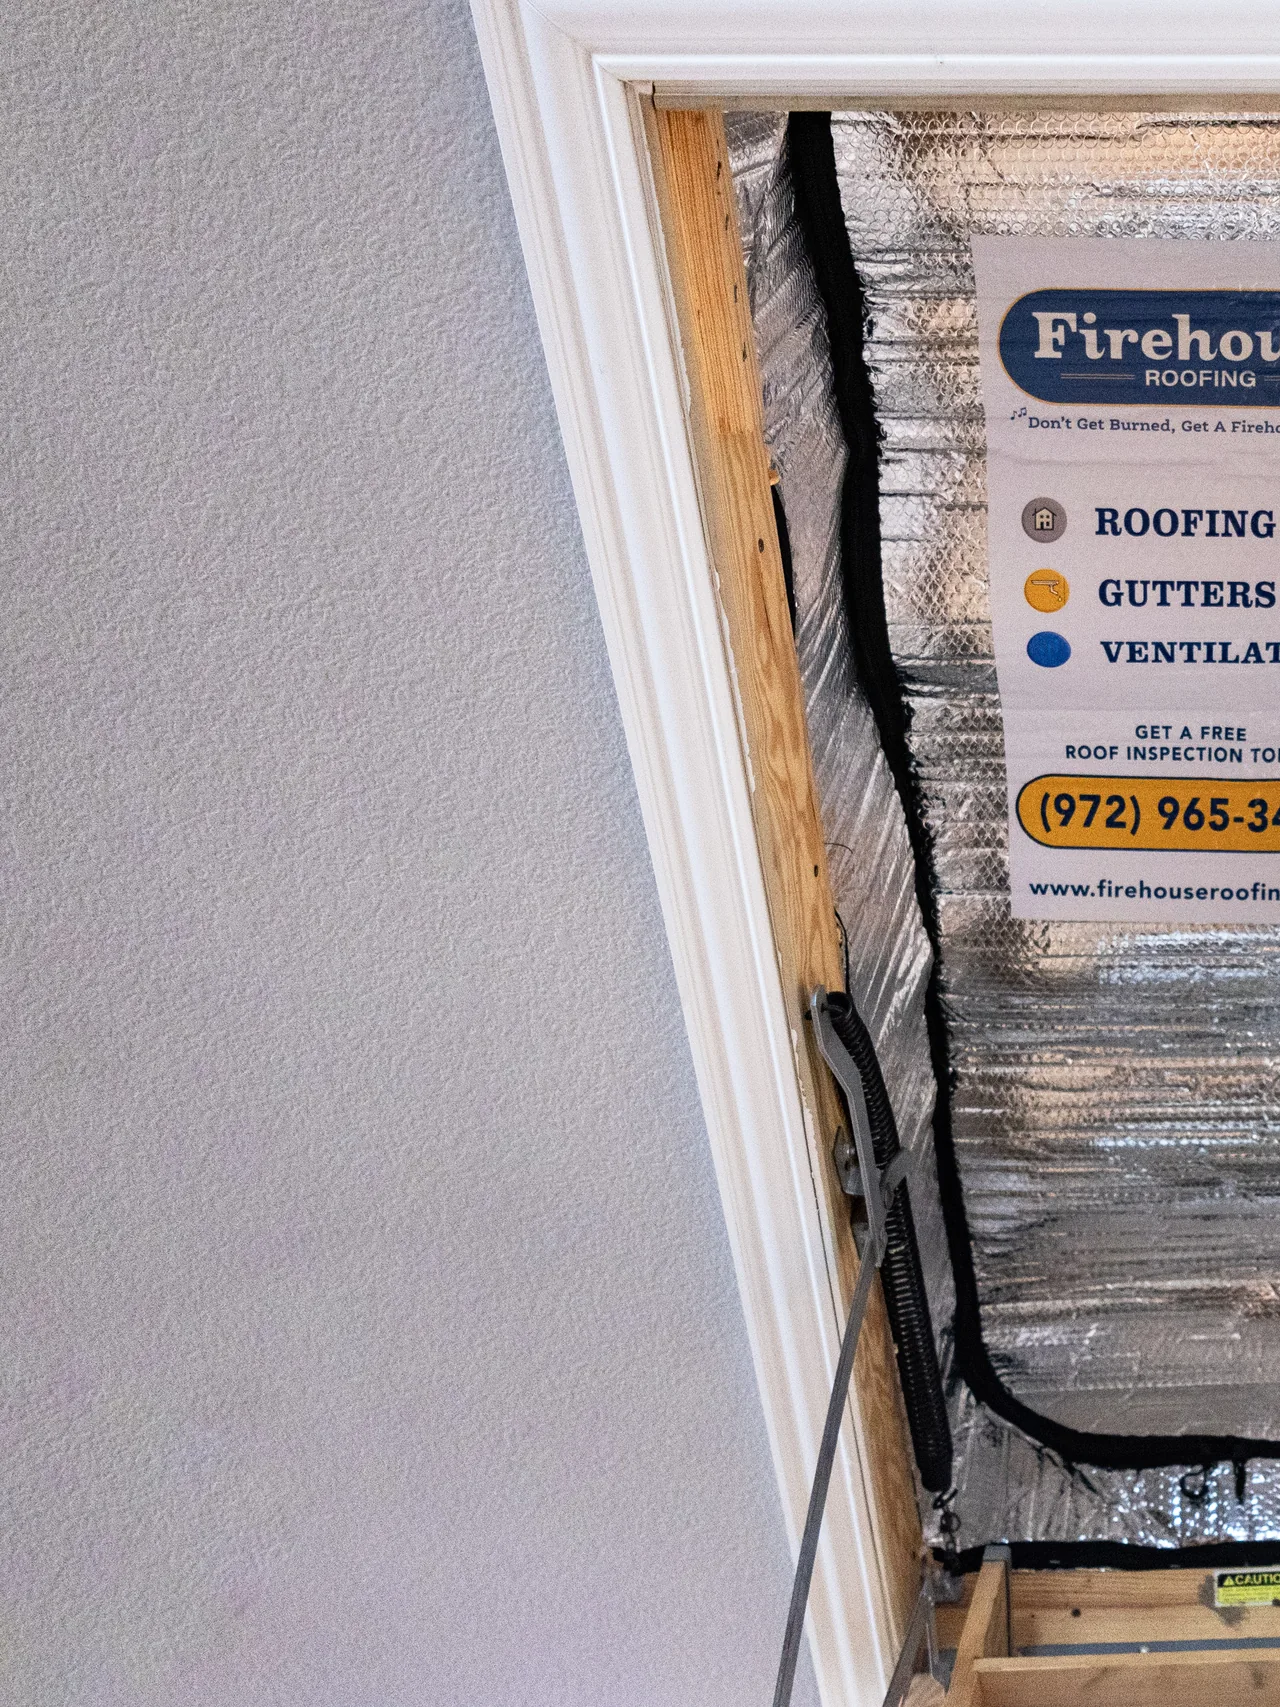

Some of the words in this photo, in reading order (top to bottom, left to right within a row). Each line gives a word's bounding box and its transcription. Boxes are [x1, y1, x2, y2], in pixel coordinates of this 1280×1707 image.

[1145, 369, 1256, 387] ROOFING
[1028, 416, 1072, 430] Don't
[1077, 418, 1105, 430] Get
[1109, 419, 1176, 434] Burned,
[1181, 420, 1209, 432] Get
[1213, 421, 1226, 433] A
[1095, 507, 1277, 539] ROOFING
[1098, 579, 1277, 609] GUTTERS
[1135, 725, 1172, 740] GET
[1180, 726, 1192, 740] A
[1200, 727, 1247, 742] FREE
[1065, 745, 1120, 760] ROOF
[1126, 746, 1243, 763] INSPECTION
[1040, 792, 1141, 836] (972)
